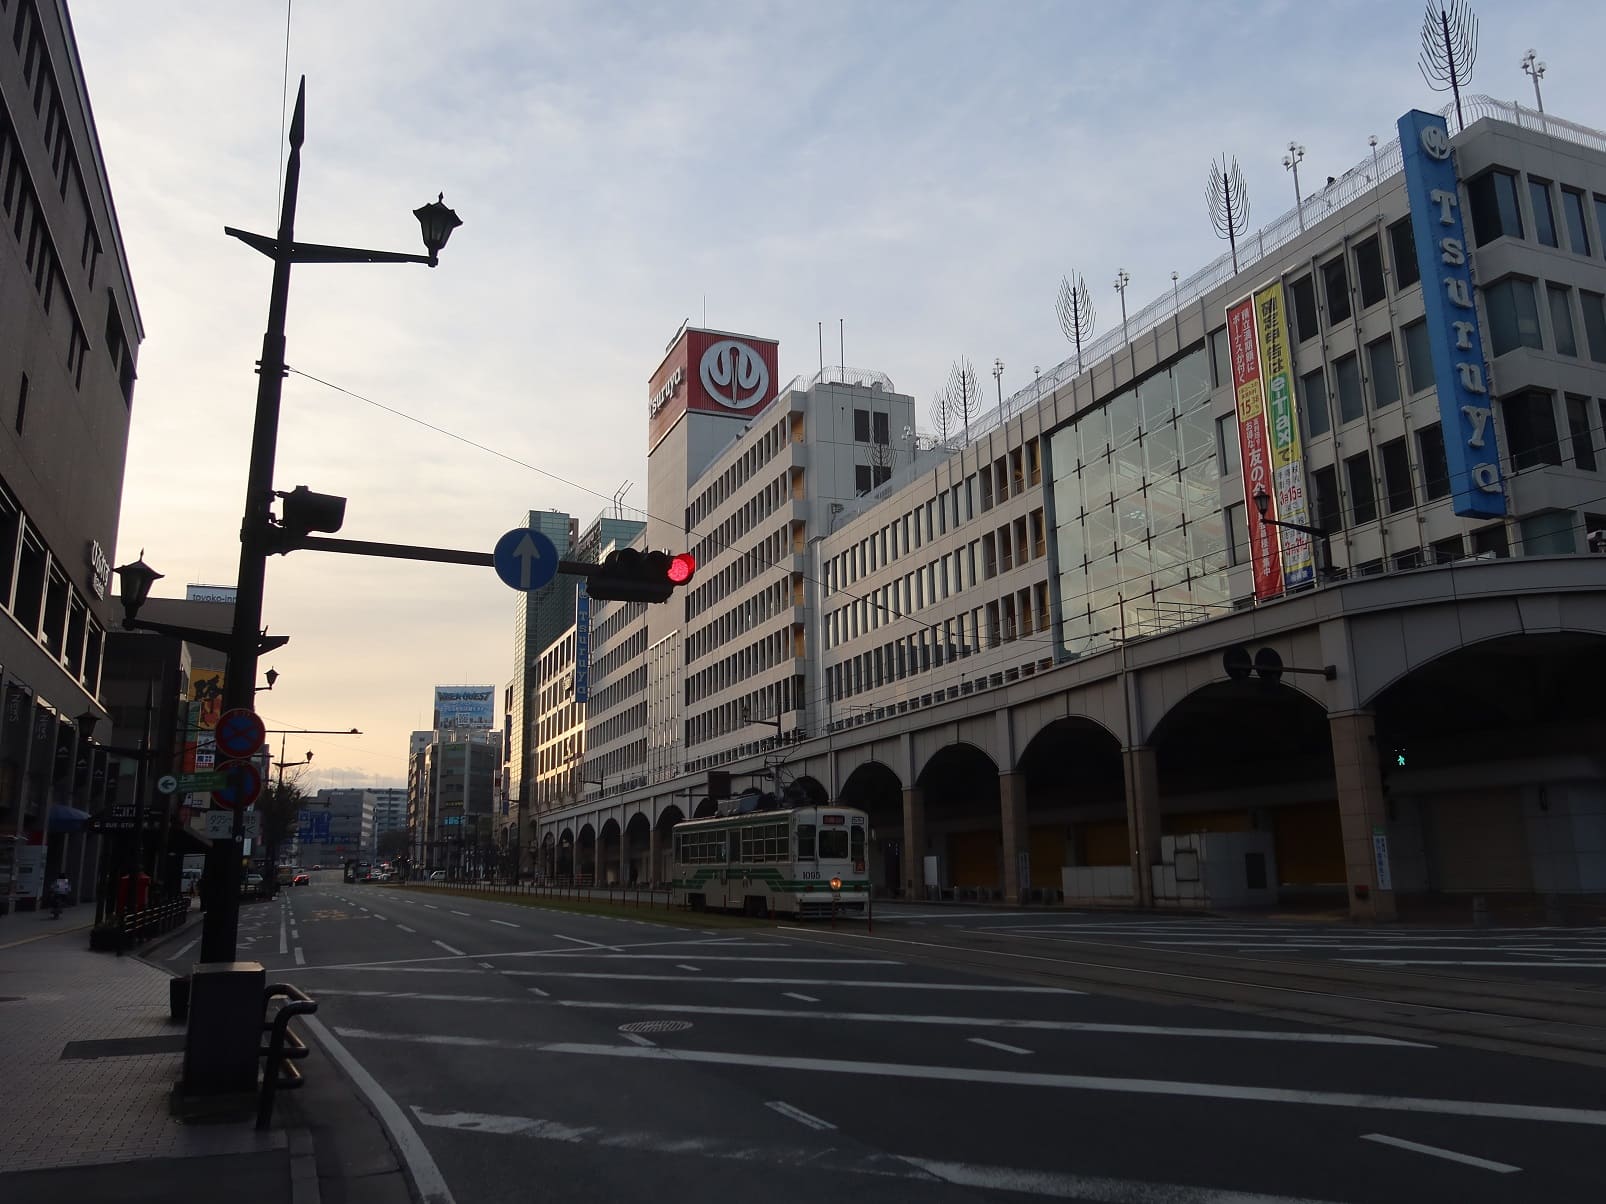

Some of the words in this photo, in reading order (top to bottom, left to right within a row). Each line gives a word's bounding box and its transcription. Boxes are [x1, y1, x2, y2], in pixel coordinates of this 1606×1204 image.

[1231, 312, 1246, 384] ボーナスが付く
[1431, 188, 1503, 494] Tsuruya
[577, 611, 589, 694] Tsuruya
[802, 871, 821, 880] 1095
